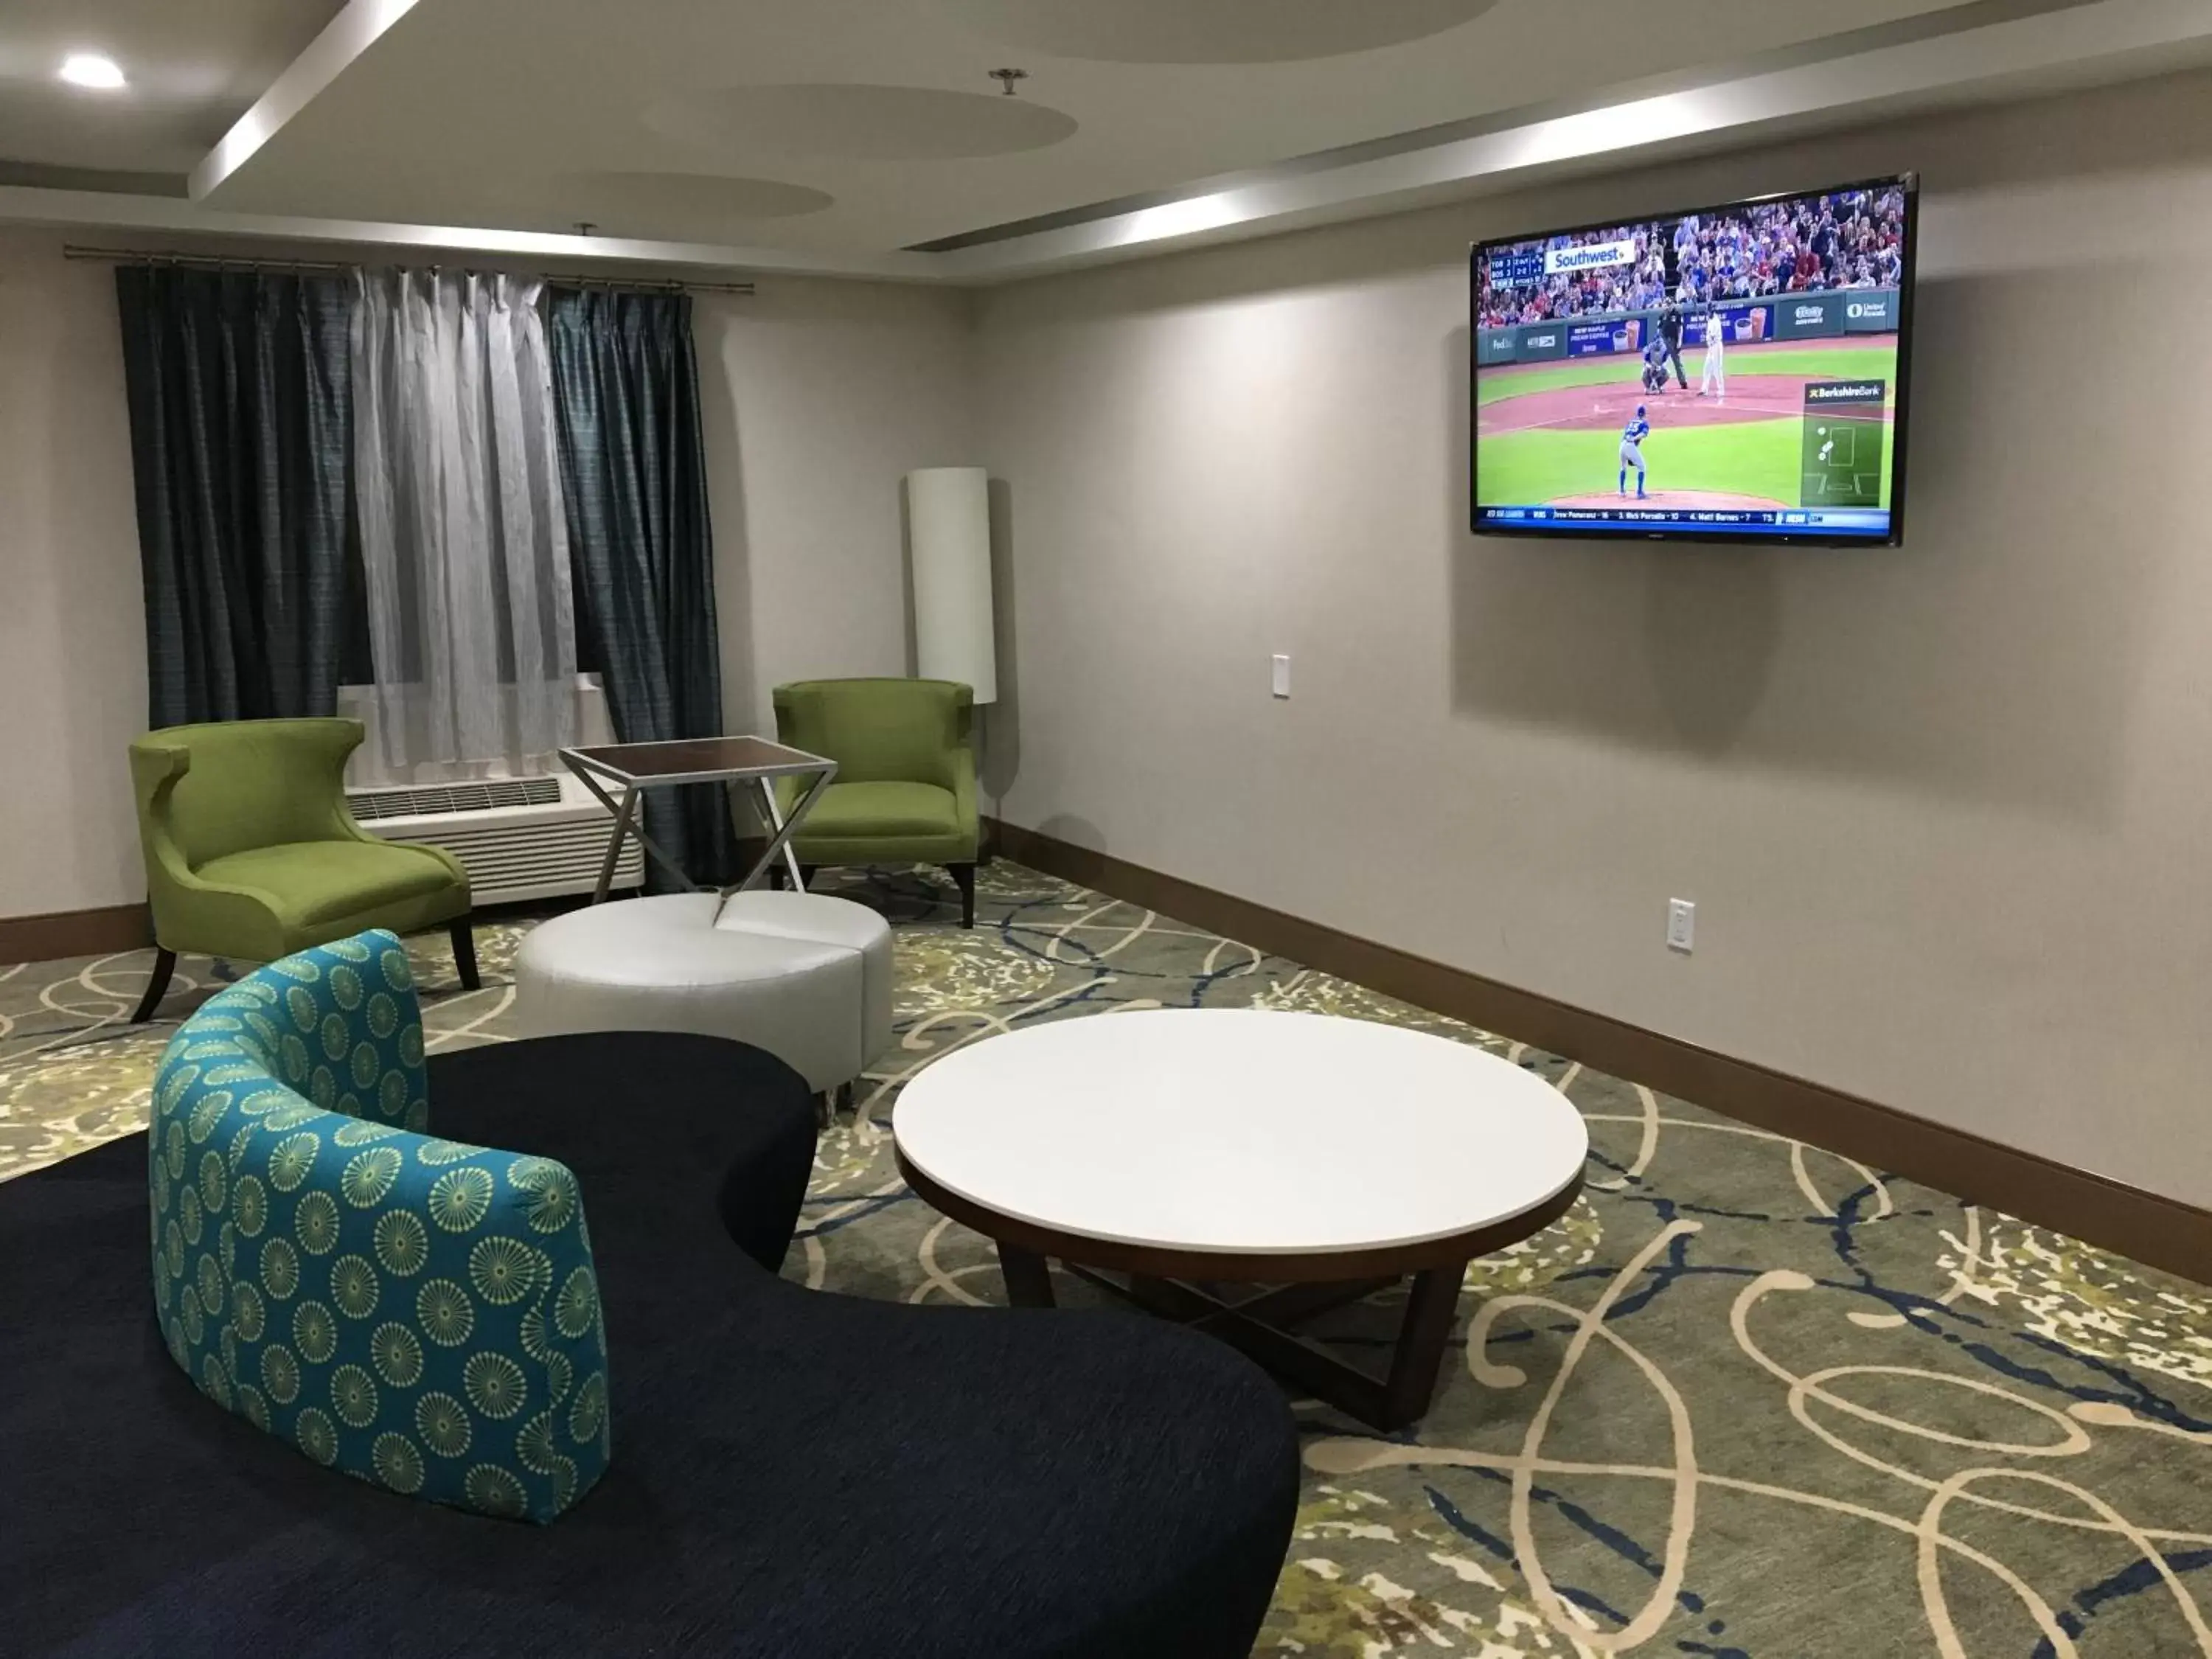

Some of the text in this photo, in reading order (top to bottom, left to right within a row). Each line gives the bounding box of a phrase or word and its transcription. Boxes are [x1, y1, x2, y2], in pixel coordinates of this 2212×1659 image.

[1555, 247, 1618, 268] Southwest
[1492, 260, 1503, 270] TOR
[1492, 269, 1503, 278] BOS
[1819, 385, 1881, 398] BerkshireBank
